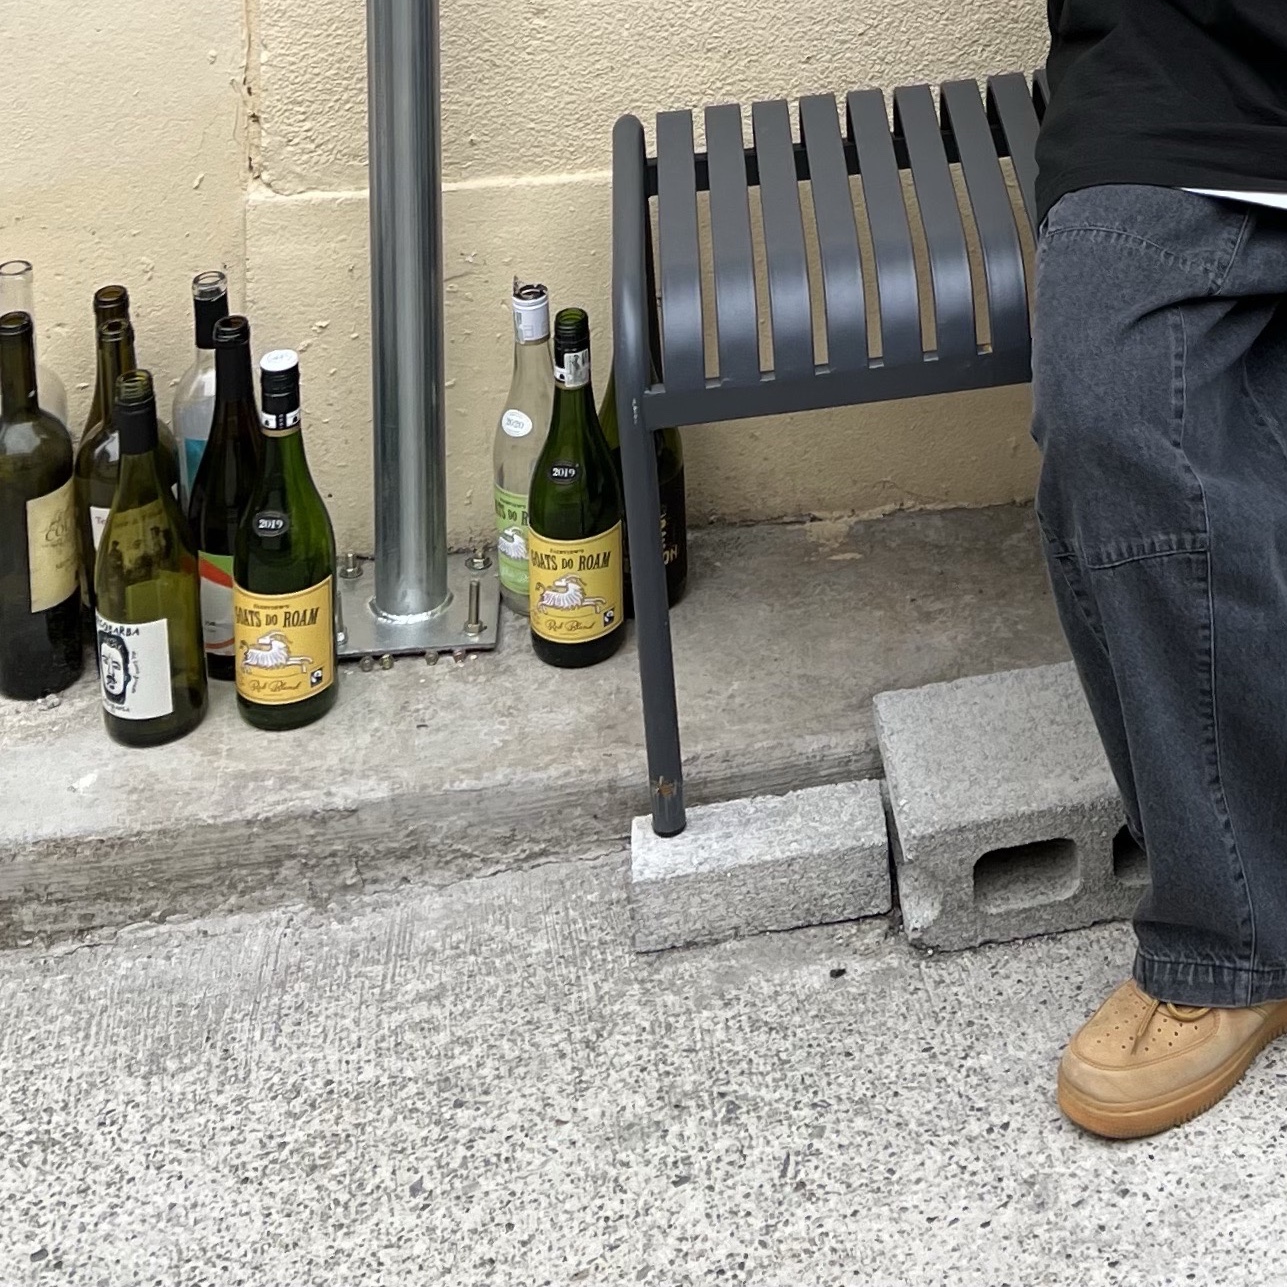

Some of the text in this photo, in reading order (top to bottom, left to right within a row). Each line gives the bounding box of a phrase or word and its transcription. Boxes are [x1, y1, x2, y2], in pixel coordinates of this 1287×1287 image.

[552, 466, 577, 479] 2019
[258, 518, 284, 530] 2019
[561, 558, 574, 569] DO
[577, 551, 611, 571] ROAM
[265, 614, 278, 626] DO
[282, 606, 320, 628] ROAM
